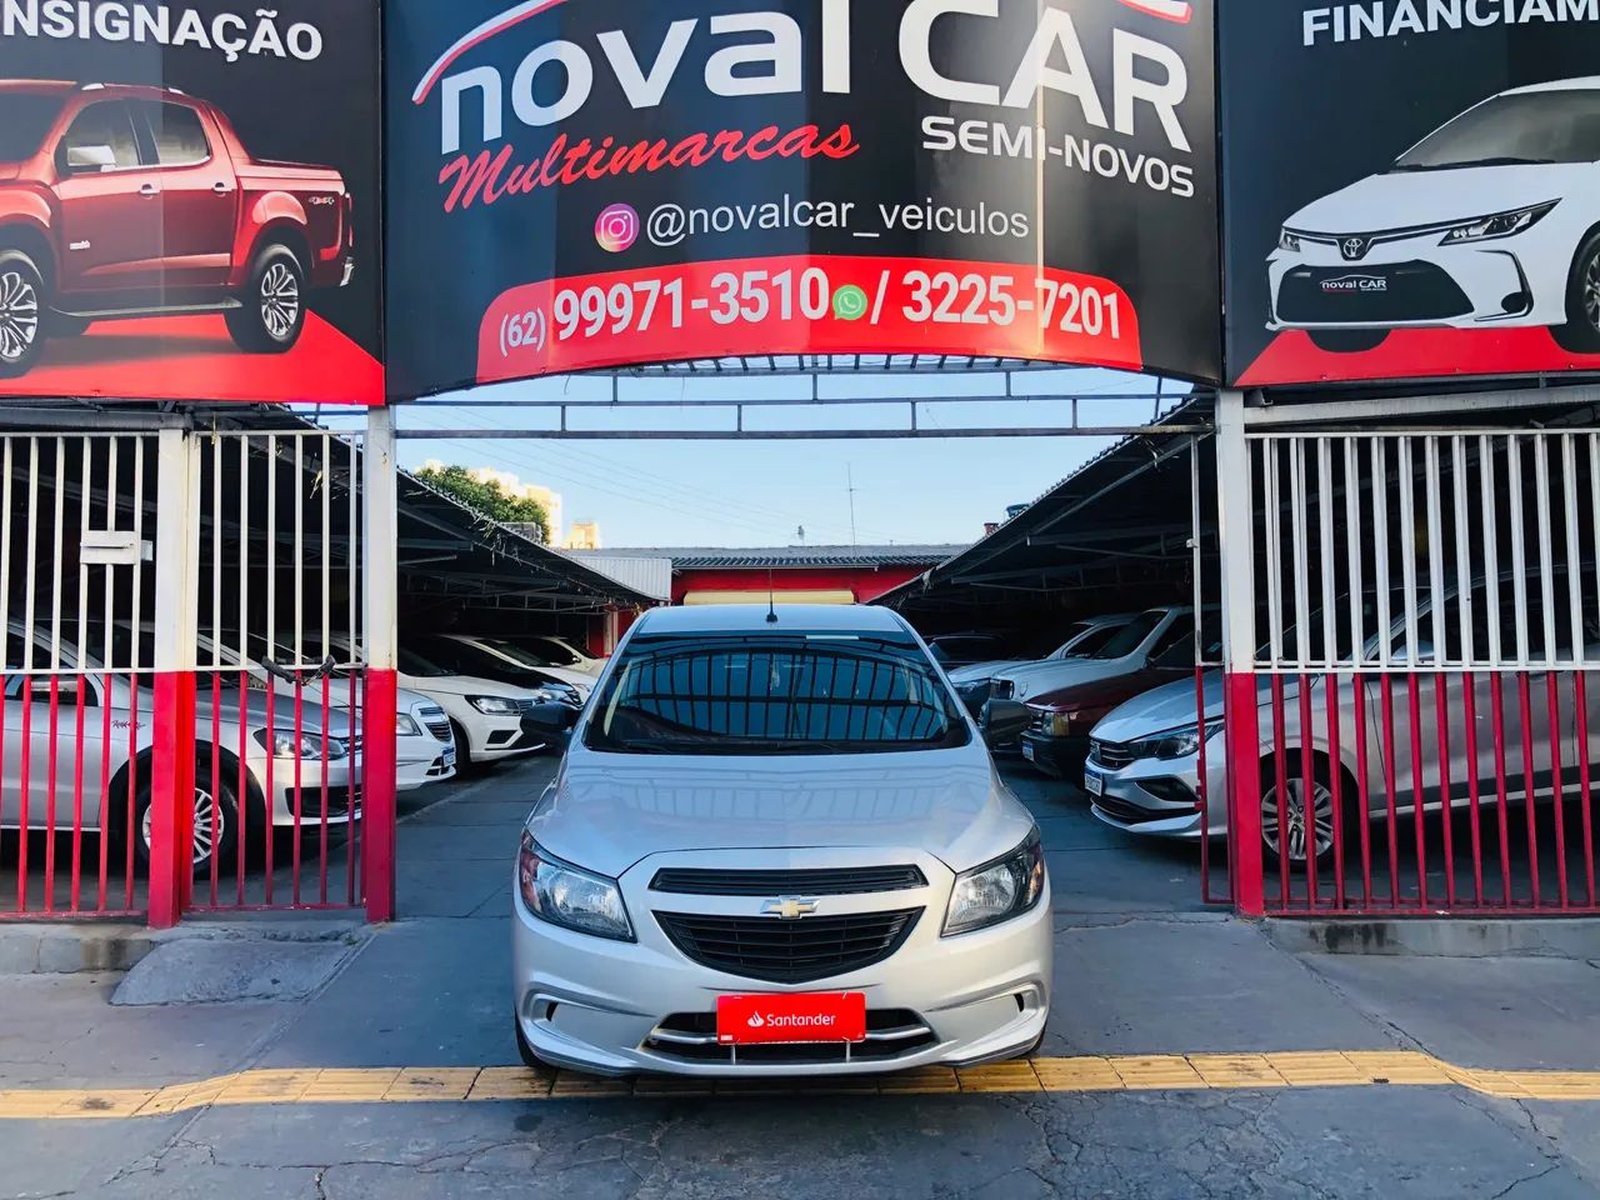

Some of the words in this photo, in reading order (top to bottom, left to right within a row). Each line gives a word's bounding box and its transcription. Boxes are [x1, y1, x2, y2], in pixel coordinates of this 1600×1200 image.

[3, 0, 324, 61] NSIGNAÇÃO
[1302, 0, 1599, 46] FINANCIAM
[441, 0, 851, 155] noval
[899, 0, 1192, 153] CAR
[438, 123, 860, 214] Multimarcas
[921, 115, 1195, 198] SEMI-NOVOS
[646, 194, 1030, 248] @novalcar_veiculos
[500, 307, 547, 358] (62)
[553, 267, 829, 341] 99971-3510
[870, 270, 890, 325] /
[902, 271, 1121, 339] 3225-7201
[1321, 279, 1357, 289] noval
[1359, 279, 1387, 288] CAR
[766, 1012, 836, 1027] Santander
